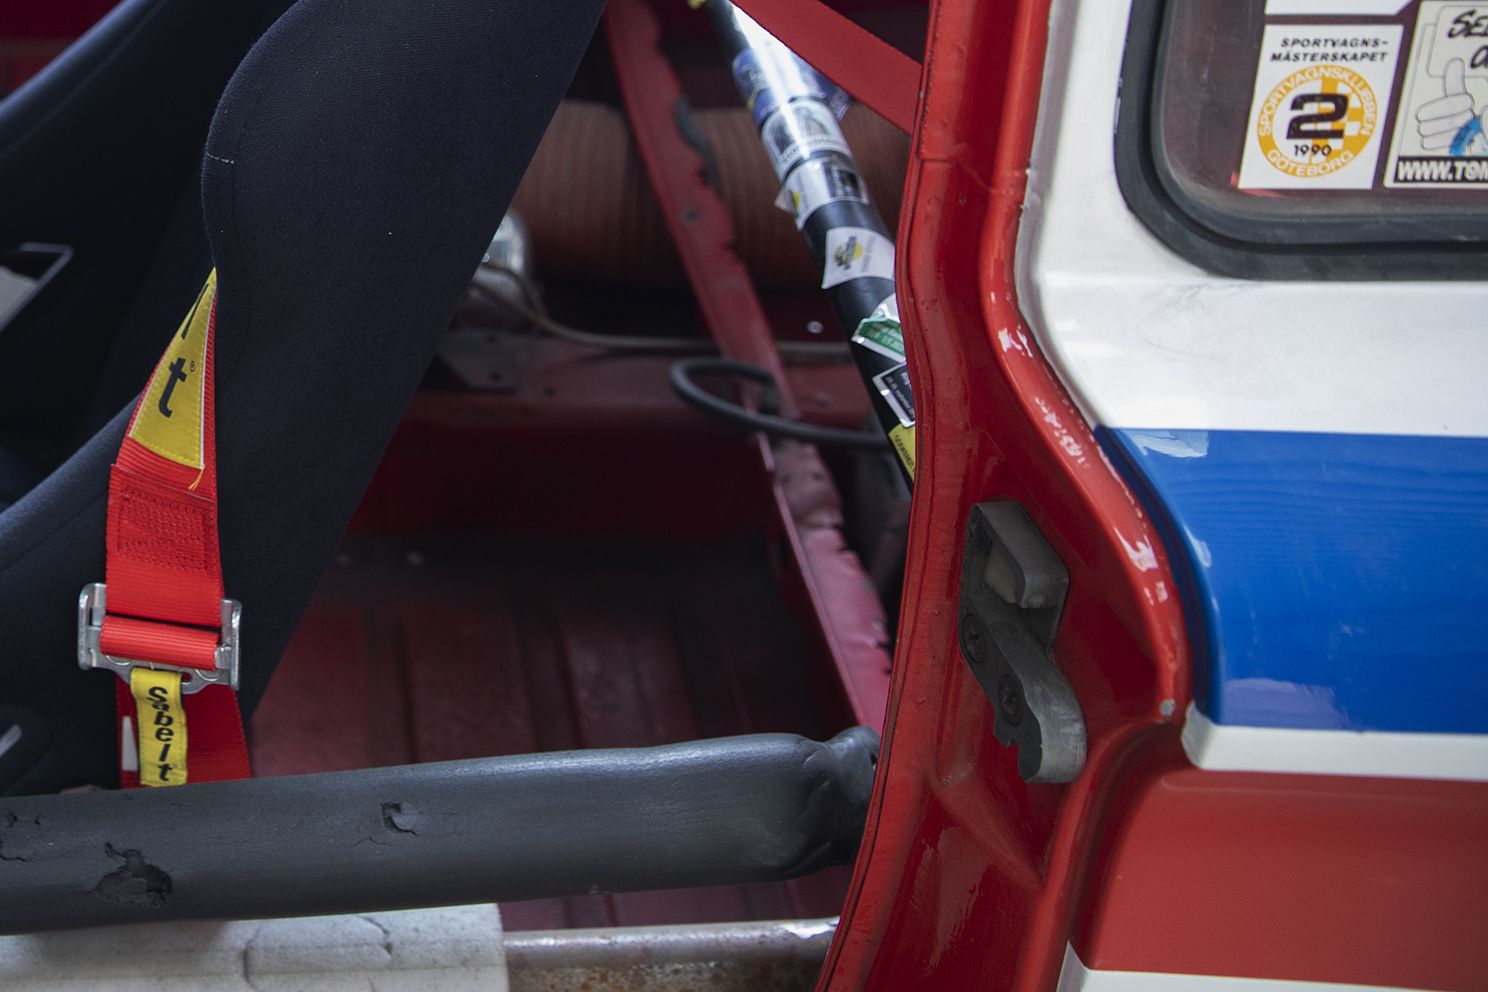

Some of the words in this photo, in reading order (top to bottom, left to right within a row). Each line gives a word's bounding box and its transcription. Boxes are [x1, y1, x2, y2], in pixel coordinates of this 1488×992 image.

[1280, 37, 1389, 48] SPORTVAGNS-
[1286, 93, 1349, 140] 2
[1293, 143, 1333, 157] 1990
